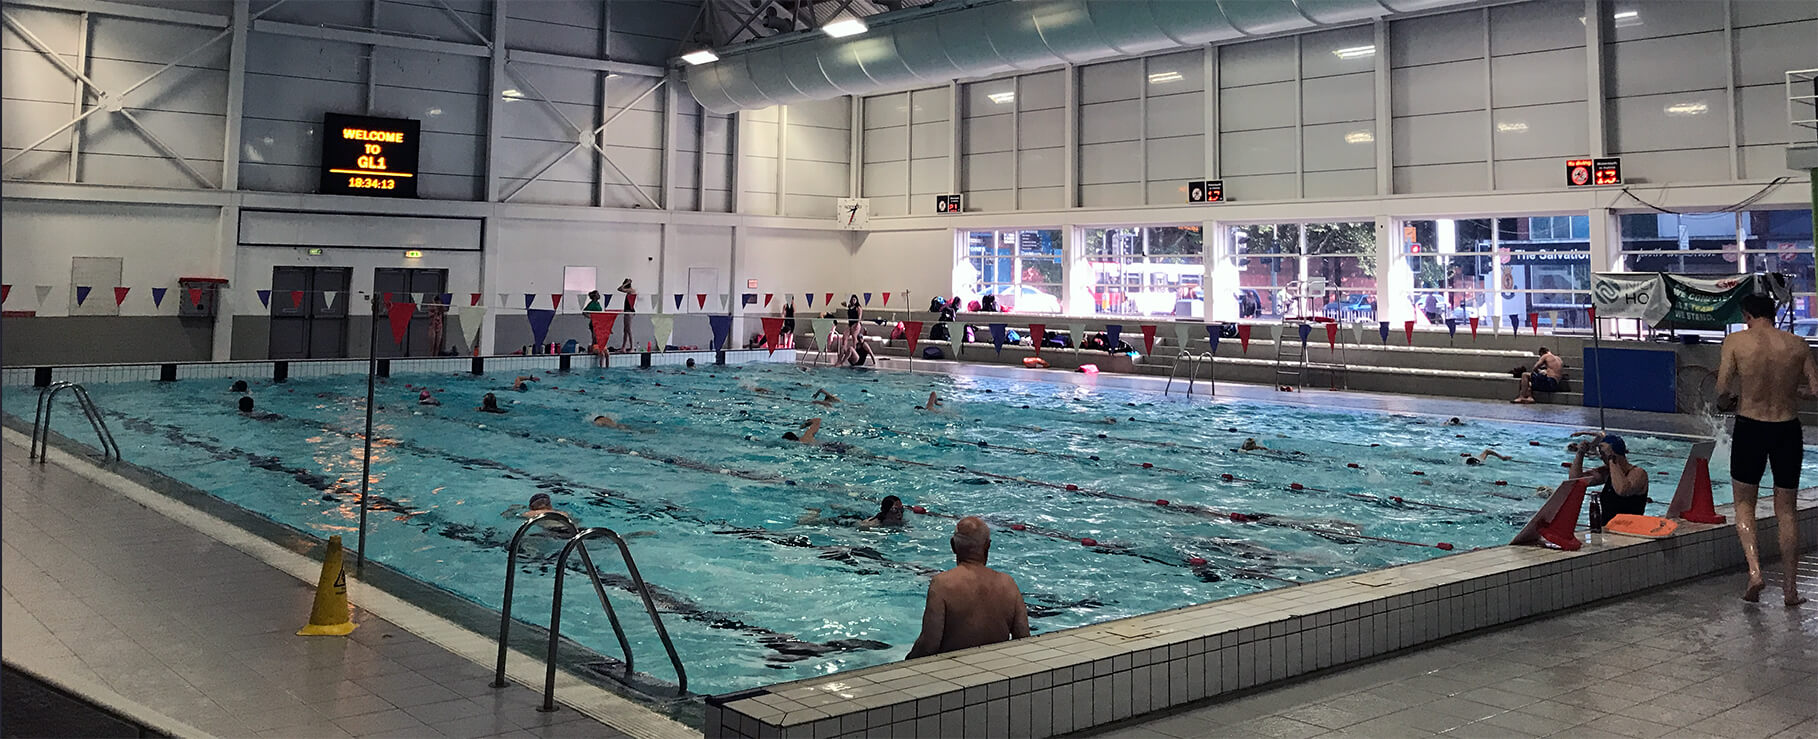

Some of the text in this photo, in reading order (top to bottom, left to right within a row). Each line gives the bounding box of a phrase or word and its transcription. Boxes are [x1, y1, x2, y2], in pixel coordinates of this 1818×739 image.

[342, 128, 404, 143] WELCOME
[364, 143, 381, 155] TO
[357, 155, 387, 170] GL1
[348, 177, 395, 190] 18:34:13
[1515, 249, 1536, 260] The
[1625, 292, 1649, 305] HO
